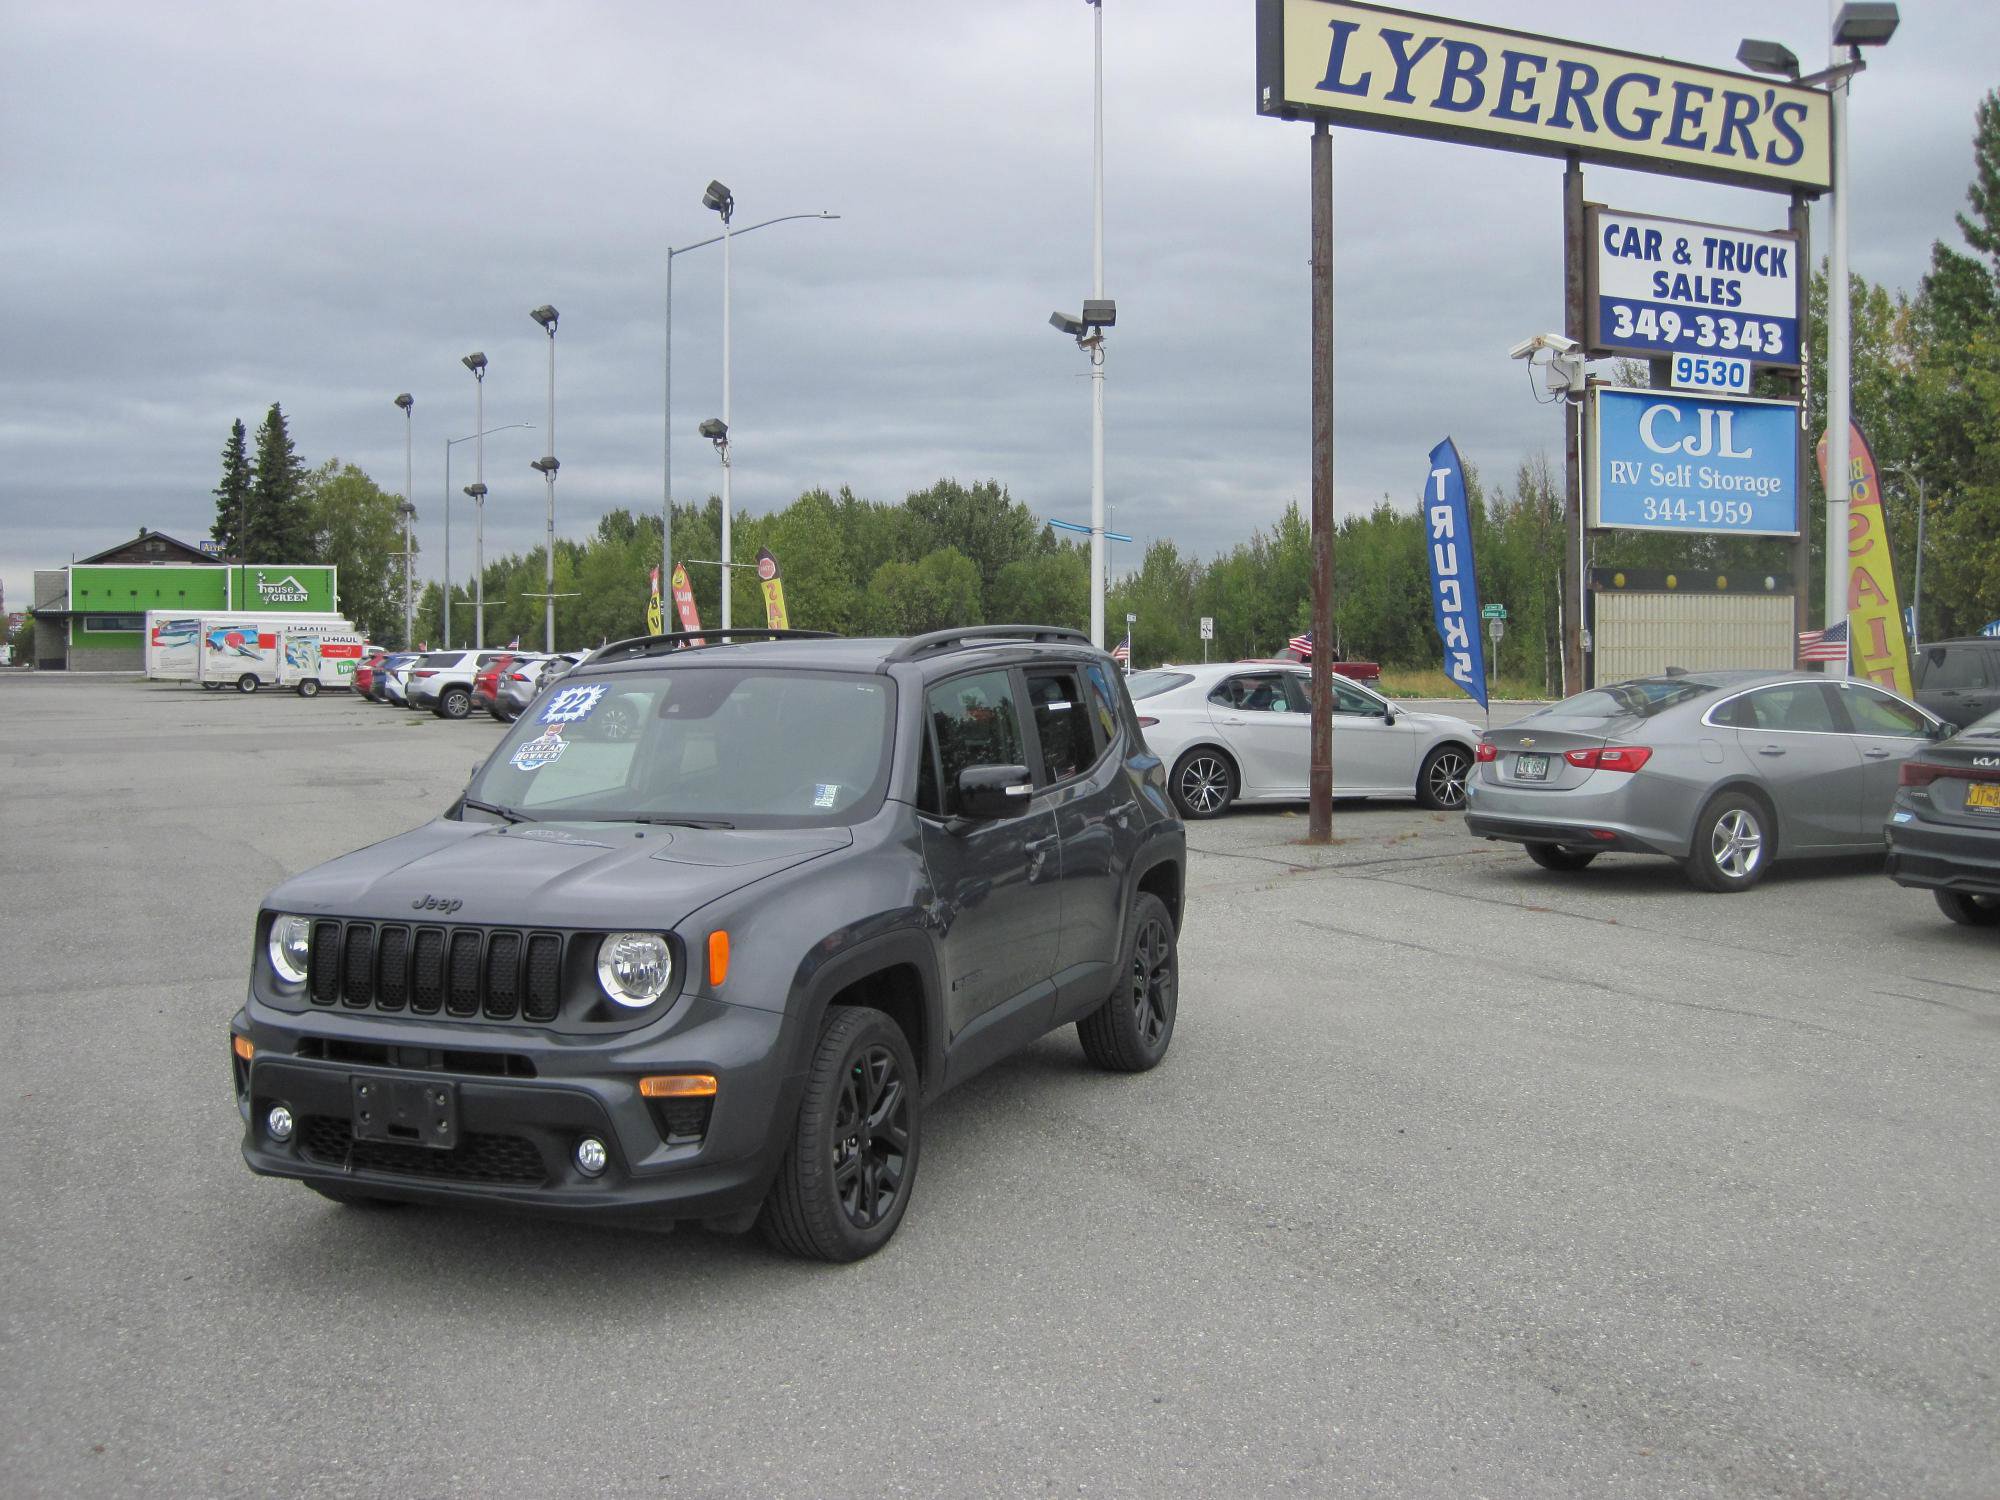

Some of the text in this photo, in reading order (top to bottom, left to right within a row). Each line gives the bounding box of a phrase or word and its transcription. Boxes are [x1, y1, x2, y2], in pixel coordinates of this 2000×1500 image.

[1317, 19, 1808, 167] LYBERGER'S
[1603, 224, 1787, 278] CAR & TRUCK
[1652, 270, 1742, 308] SALES
[1612, 305, 1783, 355] 349-3343
[1676, 357, 1745, 388] 9530
[1639, 404, 1753, 458] CJL
[1610, 460, 1782, 497] RV Self Storage
[1643, 496, 1753, 525] 344-1959
[259, 581, 294, 593] house
[271, 593, 308, 602] GREEN
[552, 692, 592, 715] 22
[412, 894, 463, 914] Jeep
